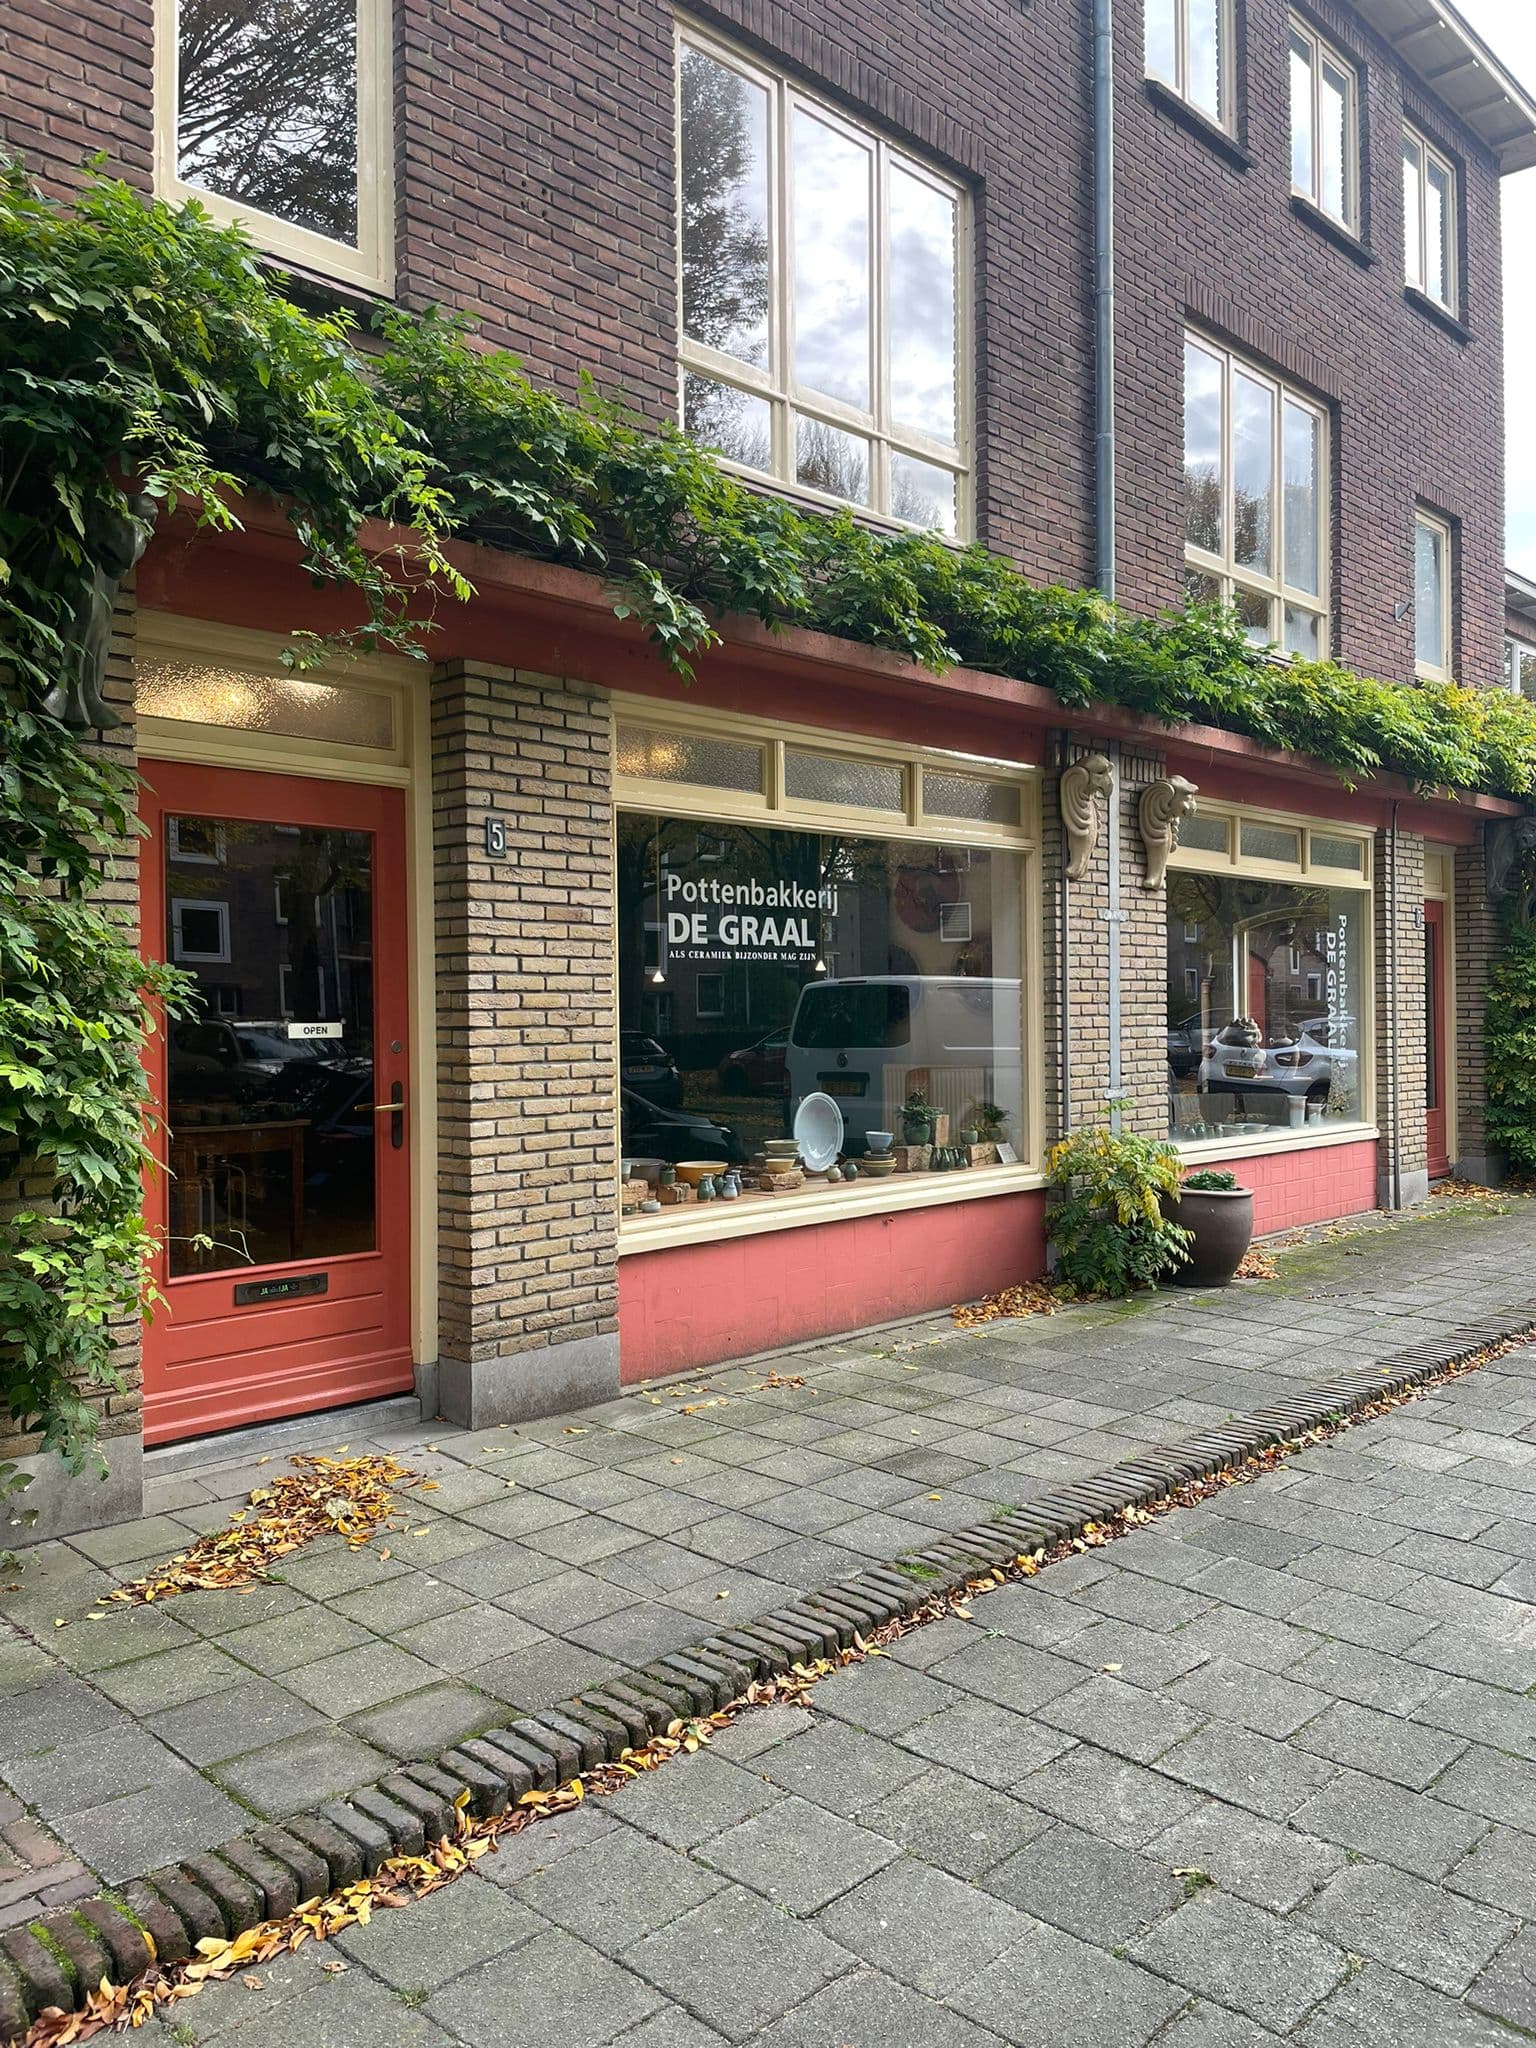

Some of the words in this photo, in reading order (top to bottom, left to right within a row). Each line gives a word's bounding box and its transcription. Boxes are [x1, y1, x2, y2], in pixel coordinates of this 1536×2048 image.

[492, 823, 503, 850] 5
[667, 874, 838, 916] Pottenbakkerij
[667, 912, 709, 945] DE
[718, 914, 816, 947] GRAAL
[668, 950, 686, 959] ALS
[688, 950, 732, 960] CERAMIEK
[735, 951, 778, 960] BIJZONDER
[780, 952, 797, 961] MAG
[799, 952, 817, 961] ZIJN
[1327, 932, 1337, 963] DE
[1338, 914, 1349, 1068] Pottenbakkeij
[1327, 969, 1337, 1051] GRAAL
[303, 1026, 328, 1035] OPEN
